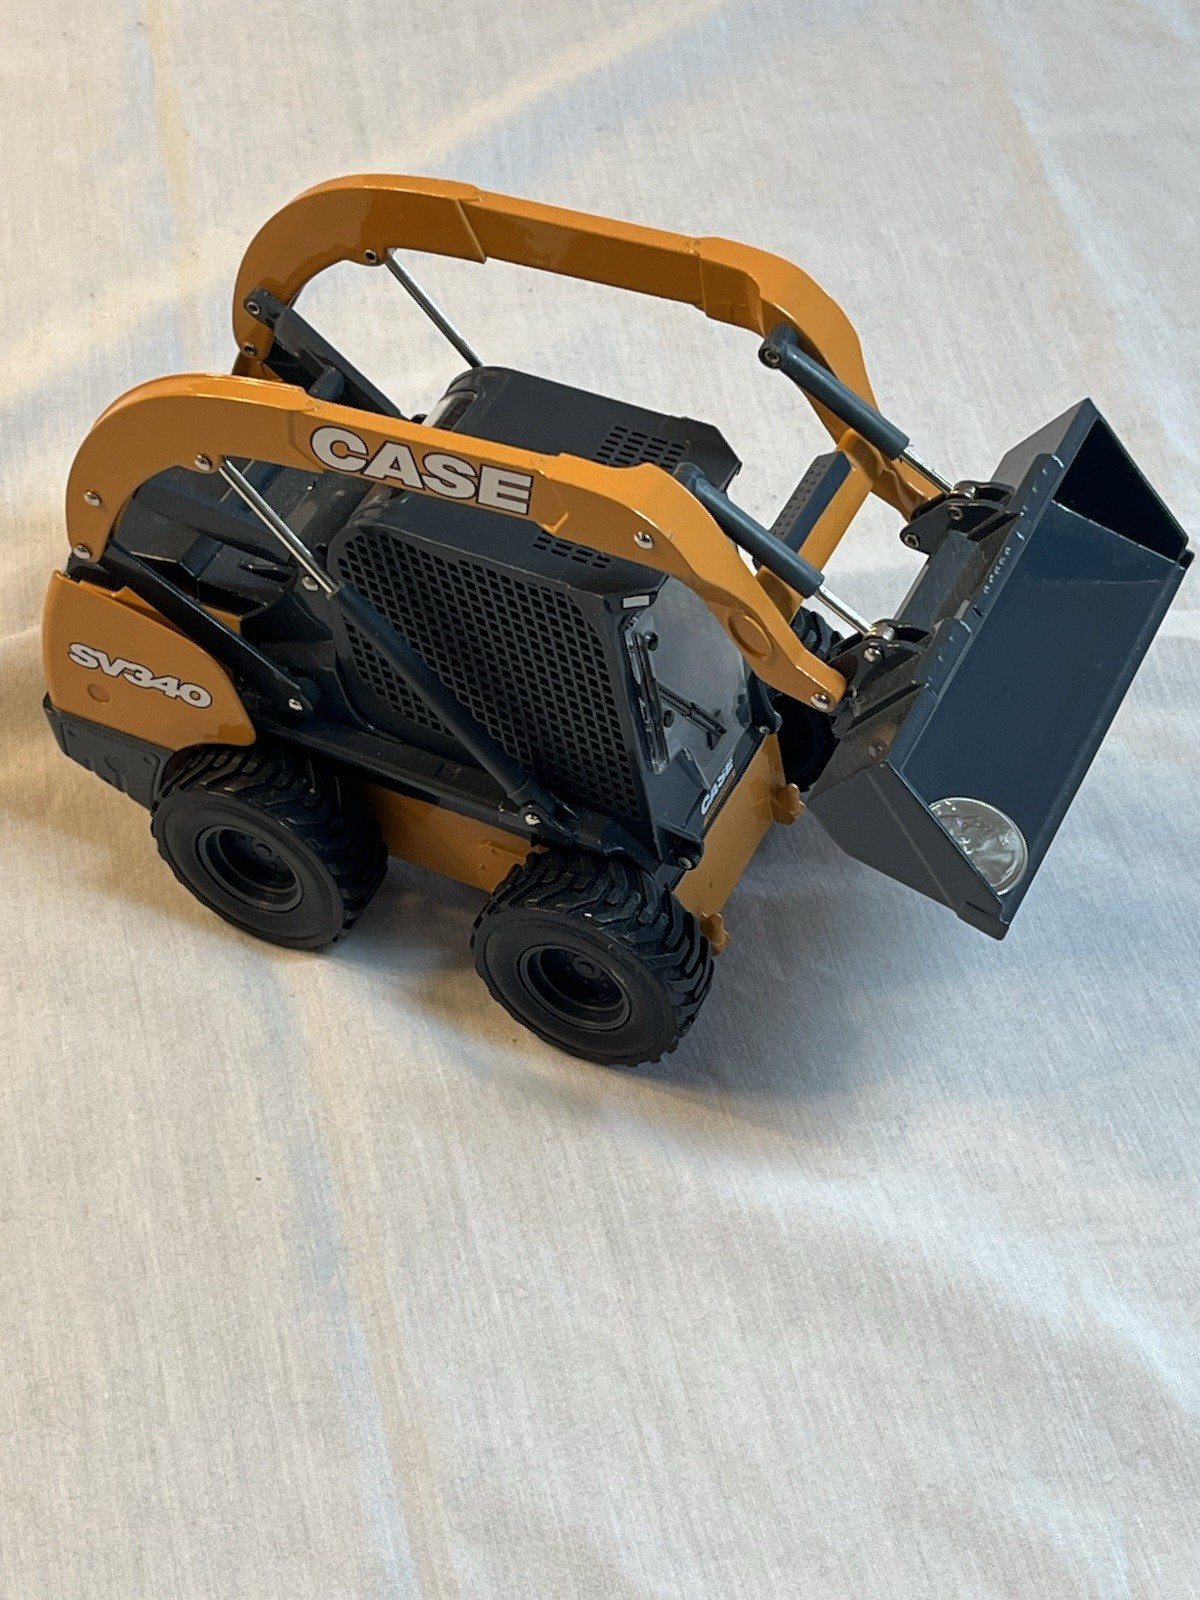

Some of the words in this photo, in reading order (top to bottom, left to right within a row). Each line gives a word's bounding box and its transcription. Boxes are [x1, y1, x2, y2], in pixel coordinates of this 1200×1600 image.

[310, 426, 533, 515] CASE
[68, 642, 213, 709] SV340
[701, 758, 734, 815] CASE
